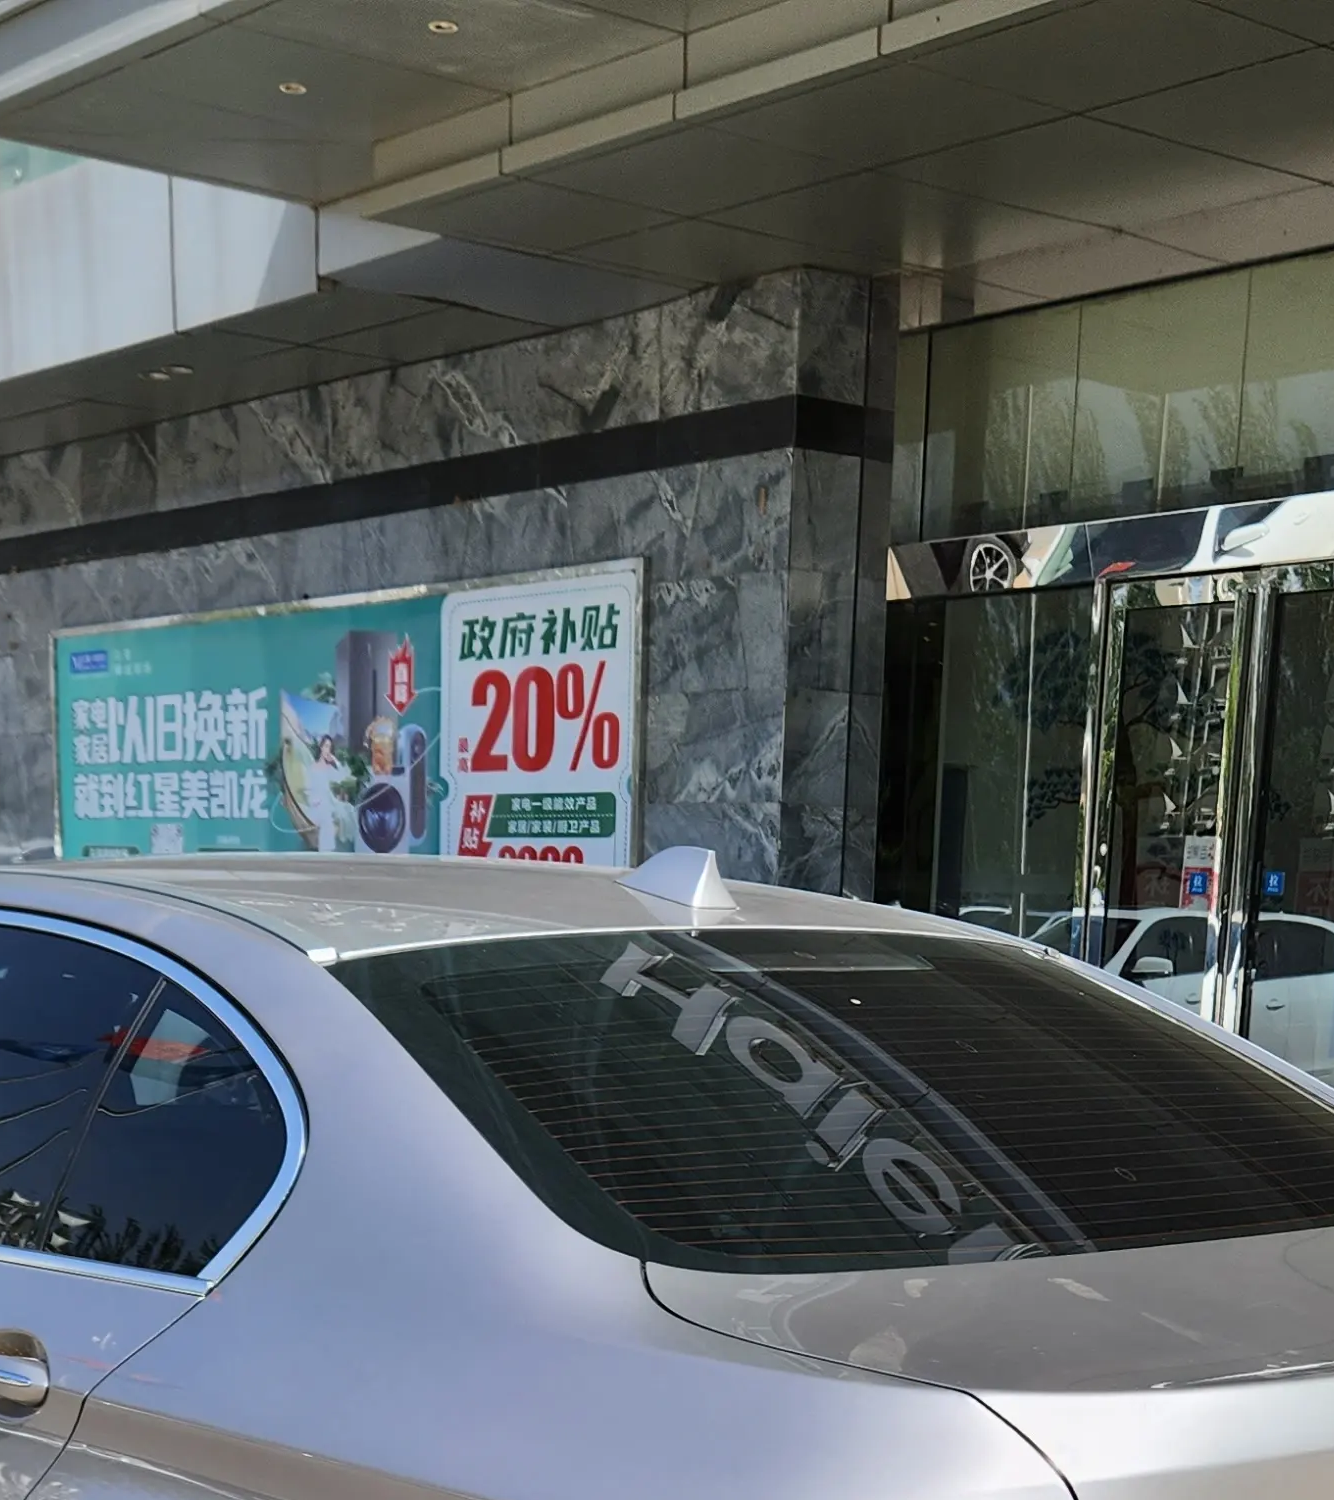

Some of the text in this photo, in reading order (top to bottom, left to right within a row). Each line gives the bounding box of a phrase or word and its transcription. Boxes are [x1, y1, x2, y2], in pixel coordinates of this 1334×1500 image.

[459, 603, 620, 661] 政府补贴
[72, 698, 108, 729] 家电
[108, 687, 268, 764] 以旧换新
[470, 660, 620, 773] 20%
[72, 733, 109, 765] 家居
[73, 769, 269, 820] 就到红星美凯龙
[461, 799, 486, 850] 补贴
